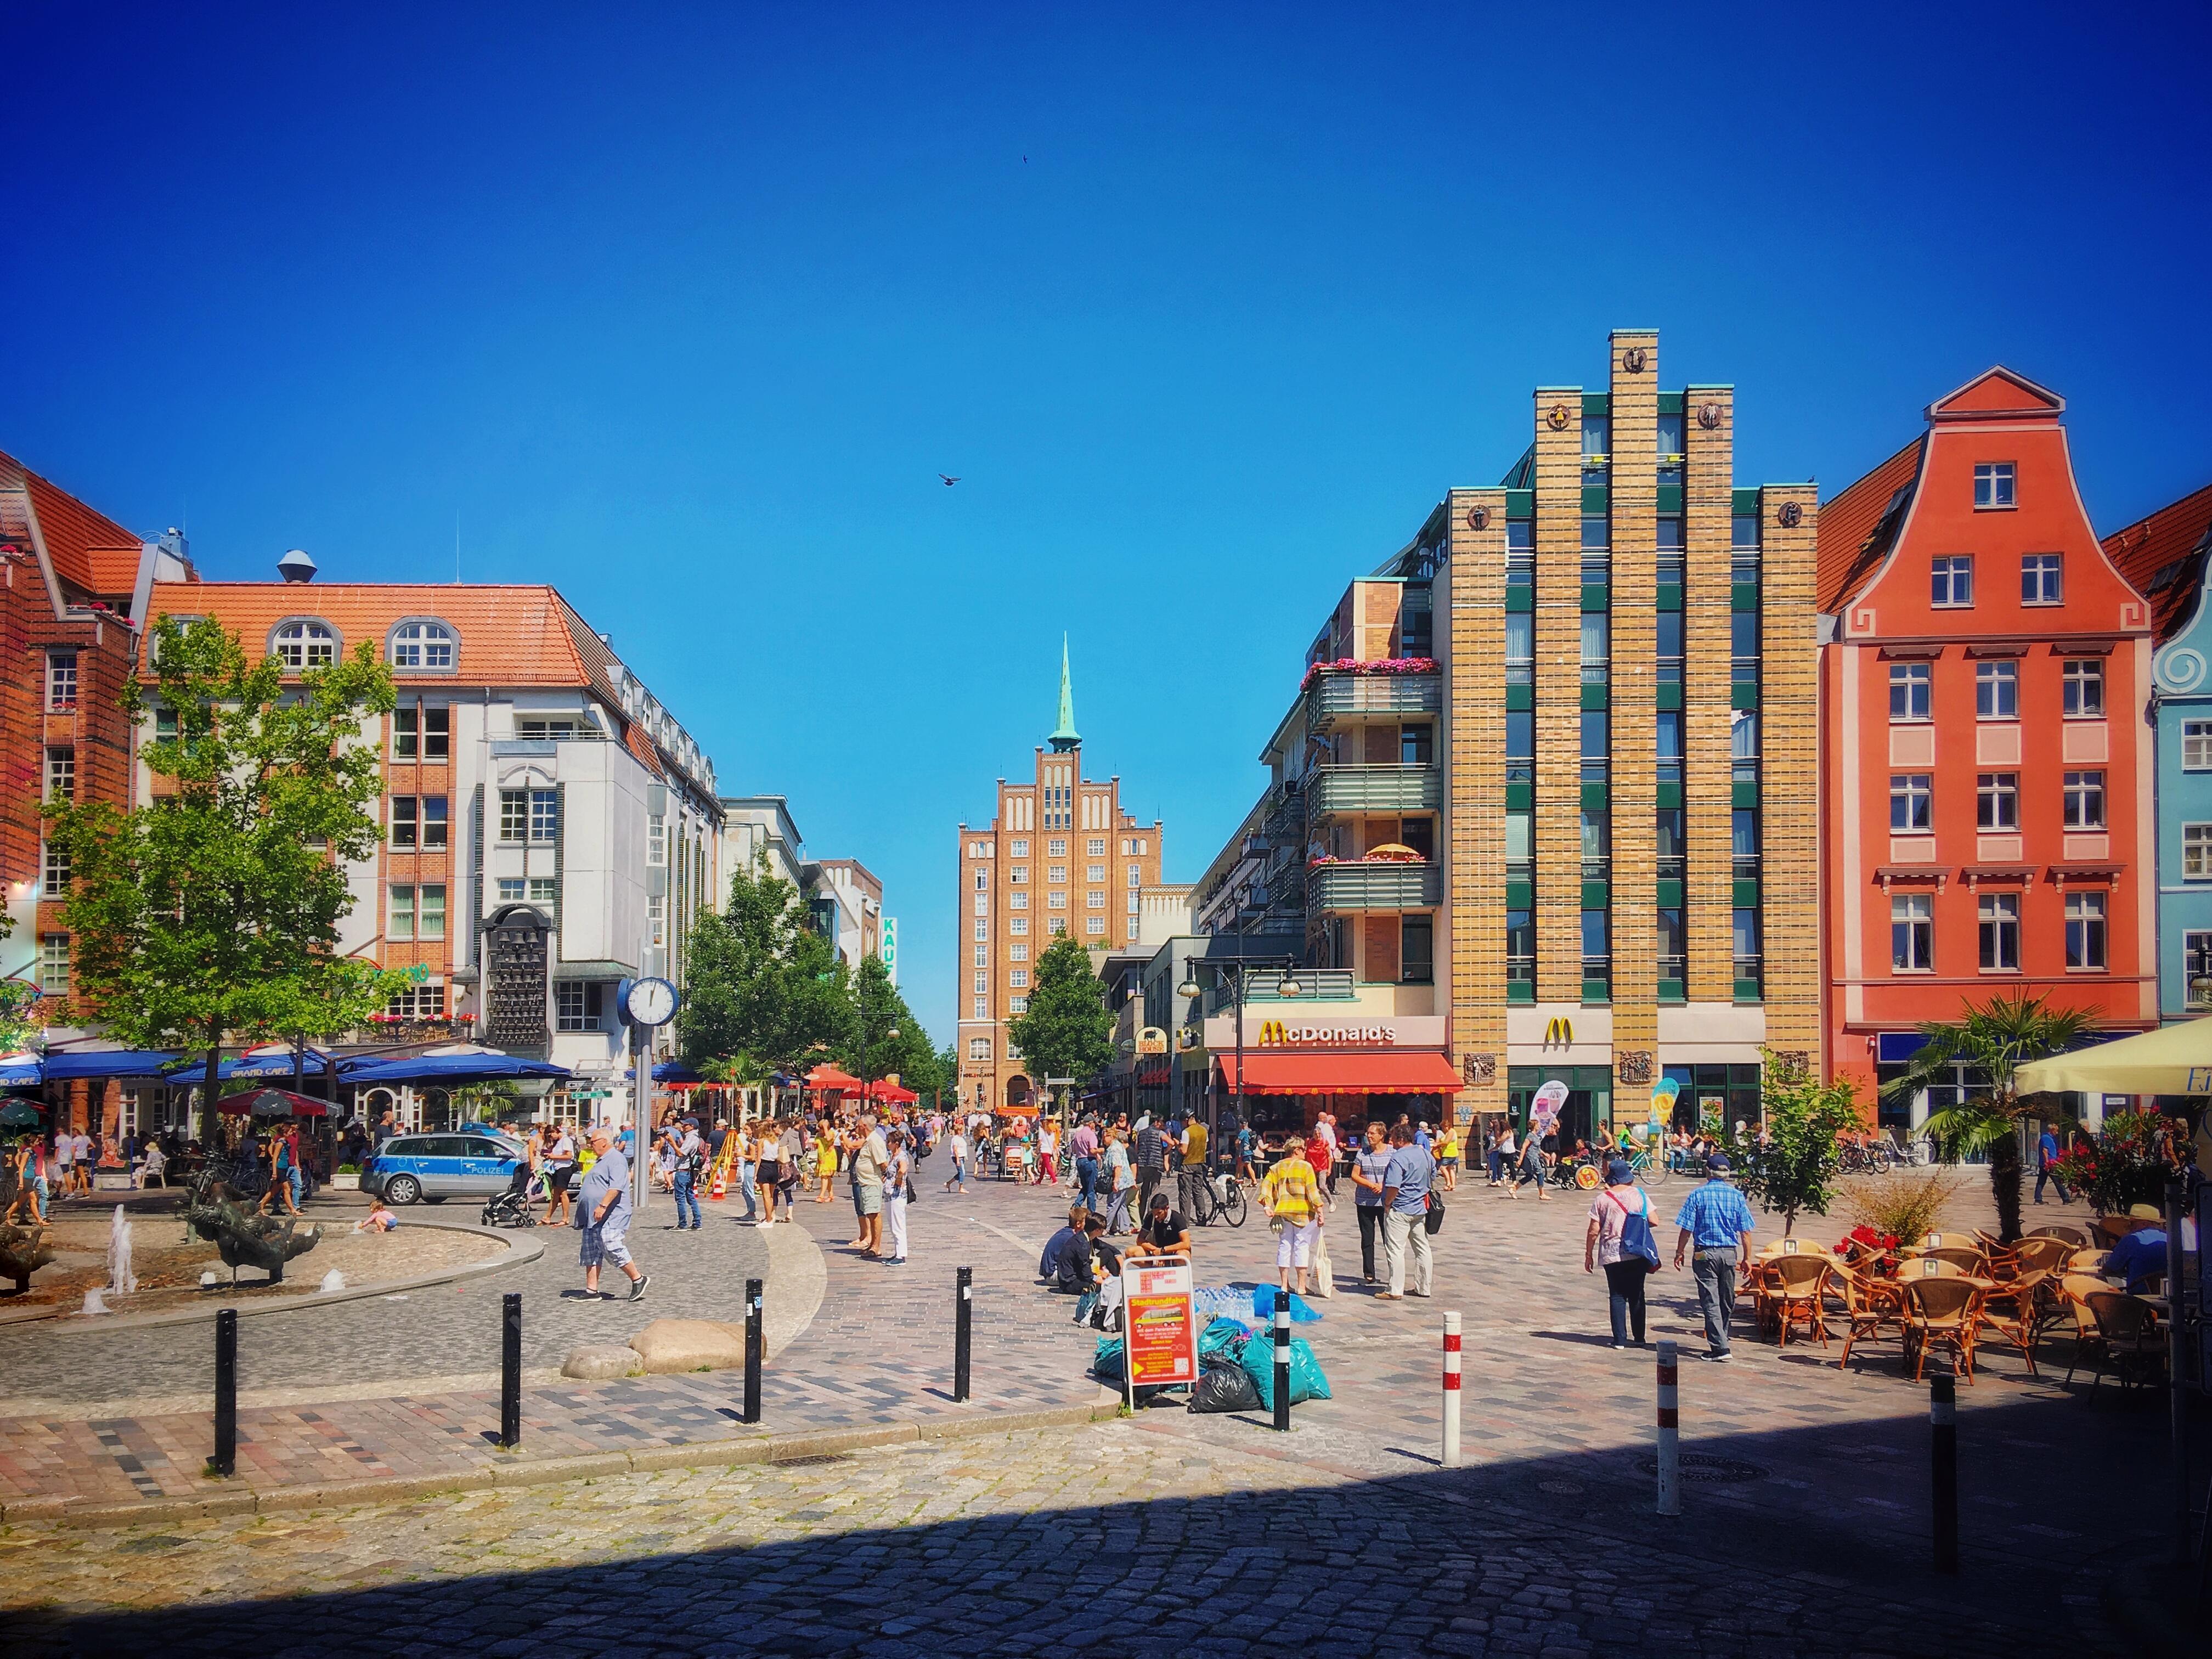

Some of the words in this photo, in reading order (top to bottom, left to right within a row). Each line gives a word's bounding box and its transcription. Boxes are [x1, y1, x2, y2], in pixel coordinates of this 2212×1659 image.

[1259, 1020, 1396, 1043] McDonald's
[230, 1068, 263, 1078] GRAND
[1131, 1296, 1187, 1306] Stadtrundfahrt
